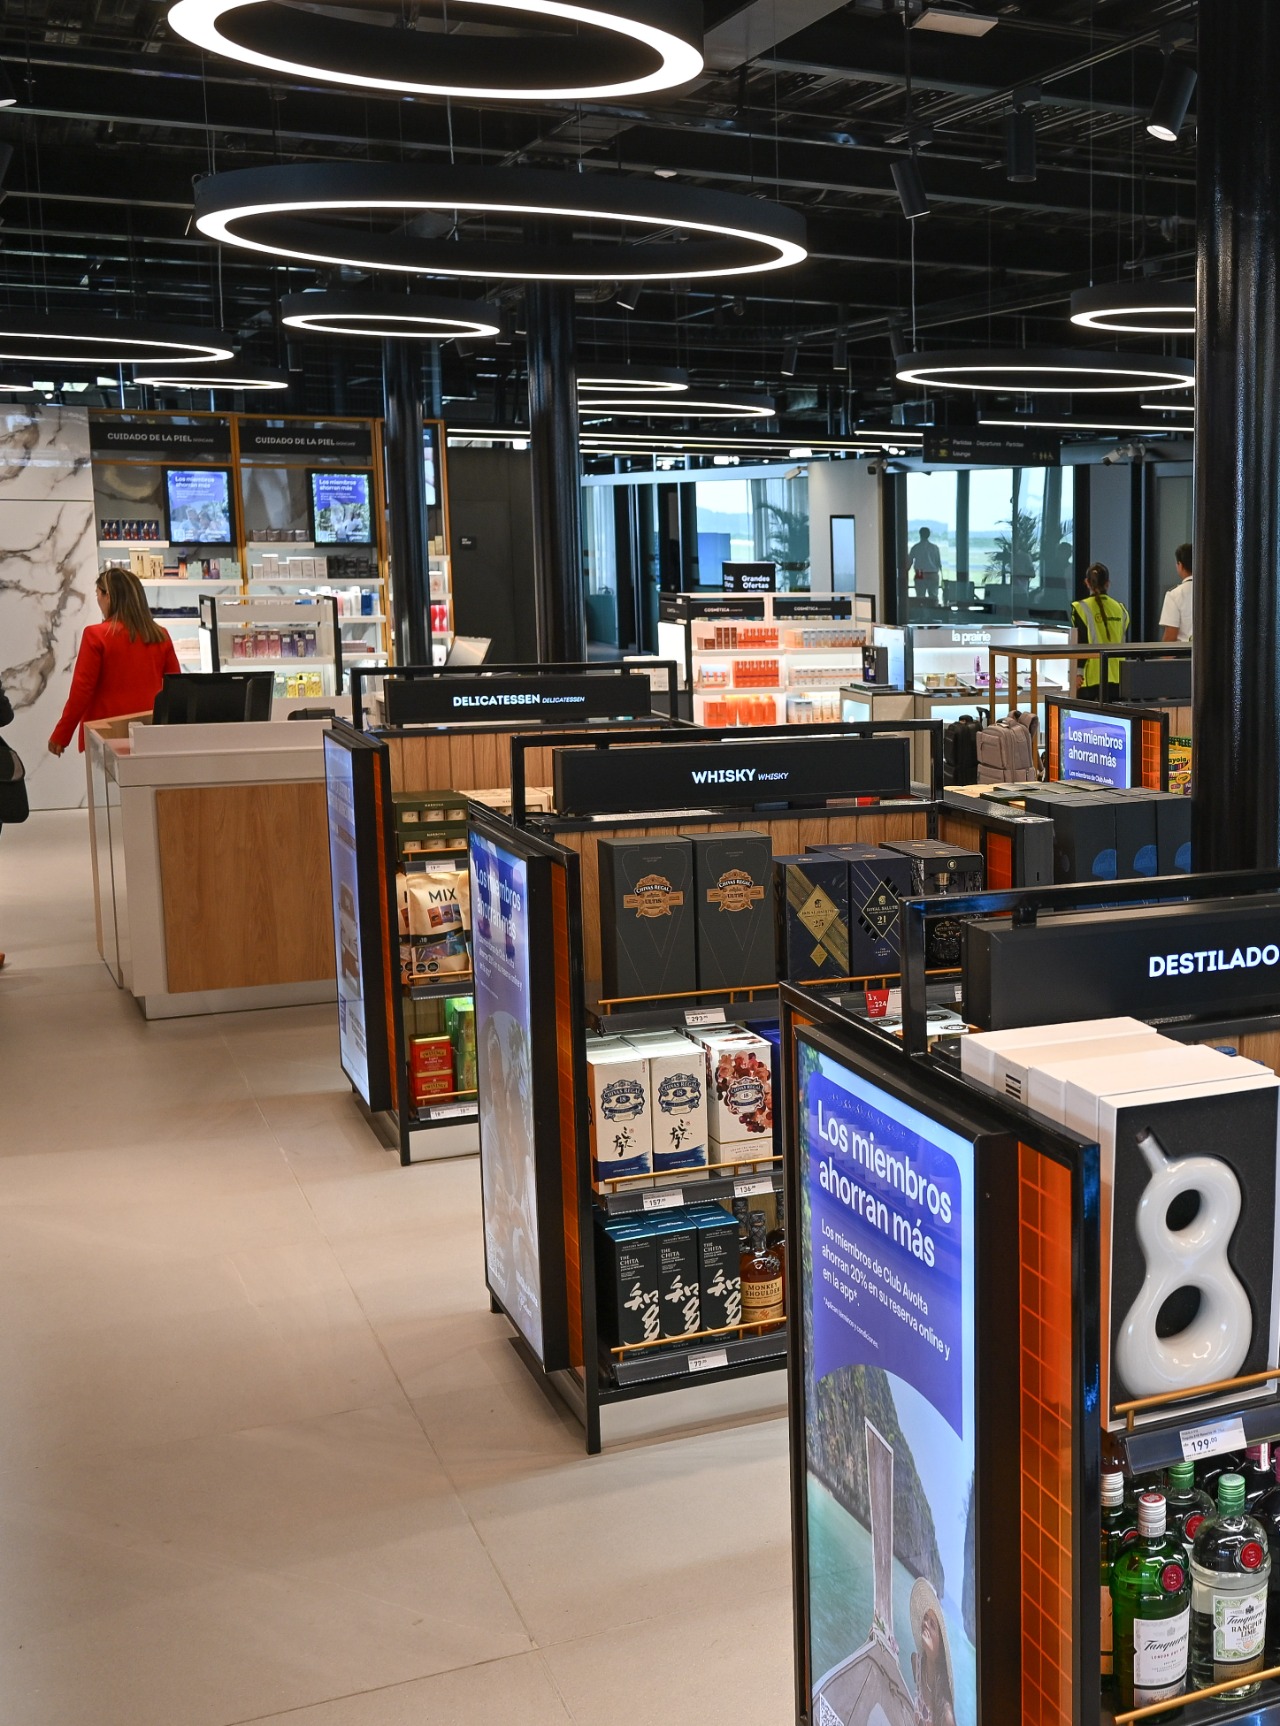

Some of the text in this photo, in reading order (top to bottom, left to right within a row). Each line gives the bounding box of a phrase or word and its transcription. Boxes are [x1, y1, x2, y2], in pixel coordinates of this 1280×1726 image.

[107, 433, 147, 441] CUIDADO
[150, 433, 159, 441] DE
[162, 434, 172, 442] LA
[255, 436, 293, 445] CUIDADO
[318, 438, 335, 446] PIEL
[741, 575, 770, 583] Grandes
[742, 581, 769, 589] Ofertas
[951, 629, 992, 645] la prairie
[453, 693, 540, 707] DELICATESSEN
[1068, 727, 1123, 750] Los miembros
[1068, 746, 1116, 768] ahorran más
[692, 768, 789, 784] WHISKY WHISKY
[475, 861, 487, 888] Los
[428, 888, 456, 903] MIX
[635, 885, 653, 894] CHIVAS
[877, 915, 887, 925] 21
[875, 1000, 887, 1008] 224
[661, 1080, 700, 1092] CHIVAS REGAL
[603, 1089, 624, 1099] CHIVAS
[818, 1100, 951, 1224] Los miembros
[819, 1156, 935, 1268] ahorran más
[661, 1251, 680, 1259] CHITA
[822, 1218, 928, 1316] Los miembros de Club Avolta
[823, 1268, 832, 1282] en
[832, 1274, 839, 1289] la
[745, 1288, 780, 1297] SHOULDER
[748, 1282, 778, 1290] MONKEY
[822, 1244, 951, 1361] ahorran 20% en su reserva online y
[1231, 1618, 1262, 1633] RANGPUR
[1241, 1628, 1257, 1638] LIME
